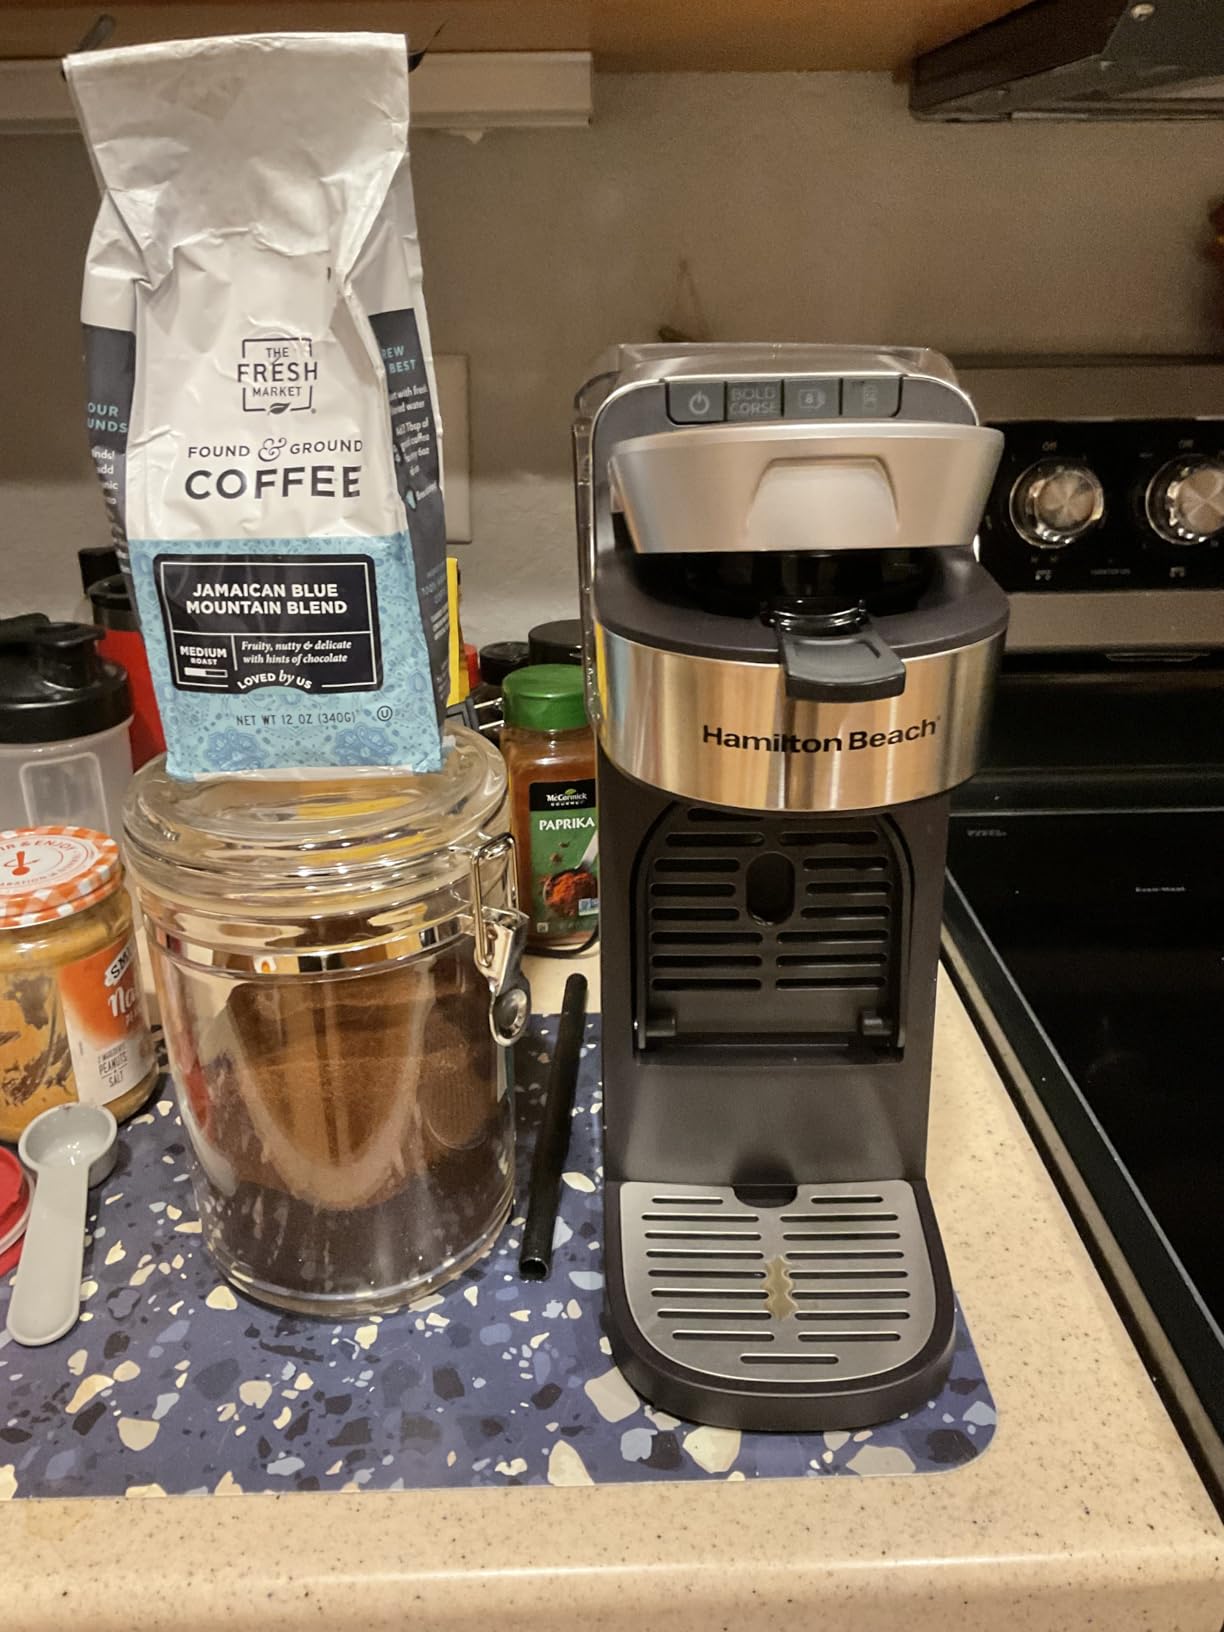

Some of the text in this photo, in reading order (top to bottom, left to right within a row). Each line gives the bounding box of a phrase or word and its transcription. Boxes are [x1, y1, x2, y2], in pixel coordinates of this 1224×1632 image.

[265, 347, 289, 359] THE
[237, 362, 319, 383] FRESH
[388, 360, 416, 374] BEST
[252, 386, 303, 398] MARKET
[188, 438, 363, 462] FOUND & GROUND
[185, 465, 361, 500] COFFEE
[193, 583, 339, 597] JAMAICAN BLUE
[186, 601, 348, 615] MOUNTAIN BLEND
[179, 645, 227, 658] MEDIUM
[241, 640, 273, 653] Fruity,
[275, 641, 301, 652] nutty
[314, 640, 352, 650] delicate
[190, 657, 218, 666] ROAST
[243, 653, 348, 666] with hints of chocolate
[237, 669, 313, 690] LOVED by US
[236, 712, 357, 727] NET WT 12 OZ (340G)
[703, 719, 936, 753] Hamilton Beach
[545, 793, 587, 802] McCormick
[539, 816, 595, 831] PAPRIKA
[108, 1070, 124, 1088] SALT
